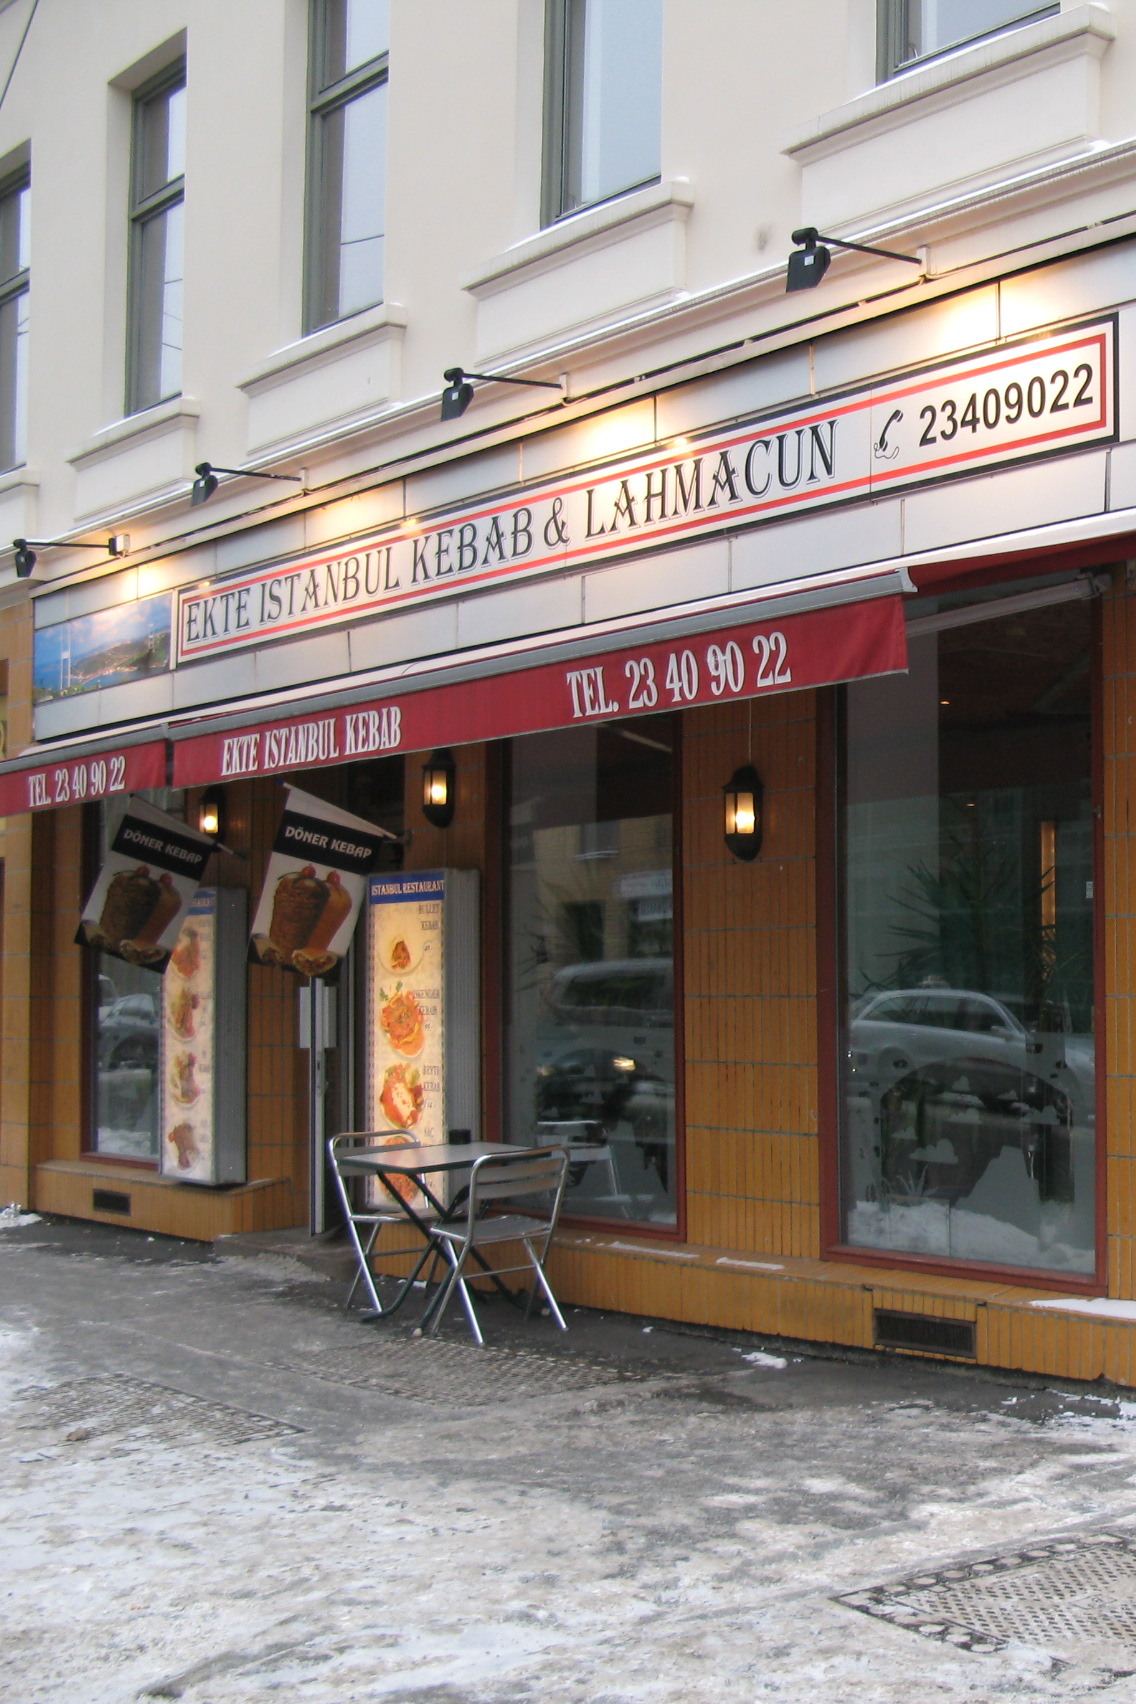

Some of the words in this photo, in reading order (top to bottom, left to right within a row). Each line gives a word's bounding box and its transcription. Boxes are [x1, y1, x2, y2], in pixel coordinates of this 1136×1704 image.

[186, 587, 250, 644] EKTE
[259, 544, 401, 624] ISTANBUL
[411, 506, 535, 585] KEBAB
[543, 496, 570, 548] &
[584, 418, 840, 540] LAHMACUN
[919, 362, 1094, 447] 23409022
[567, 666, 619, 719] TEL.
[625, 657, 659, 711] 23
[664, 648, 699, 702] 40
[706, 640, 746, 697] 90
[752, 631, 793, 689] 22
[220, 736, 260, 777] EKTE
[263, 719, 340, 771] ISTANBUL
[344, 705, 403, 753] KEBAB
[28, 774, 52, 808] TEL.
[55, 767, 71, 802] 23
[73, 764, 89, 799] 40
[90, 760, 107, 796] 90
[109, 755, 127, 791] 22
[123, 828, 164, 852] DÖNER
[165, 843, 203, 864] KEBAP
[285, 825, 328, 848] DÖNER
[331, 838, 373, 860] KEBAP
[371, 883, 402, 896] ISTANBUL
[402, 879, 445, 894] RESTAURANT
